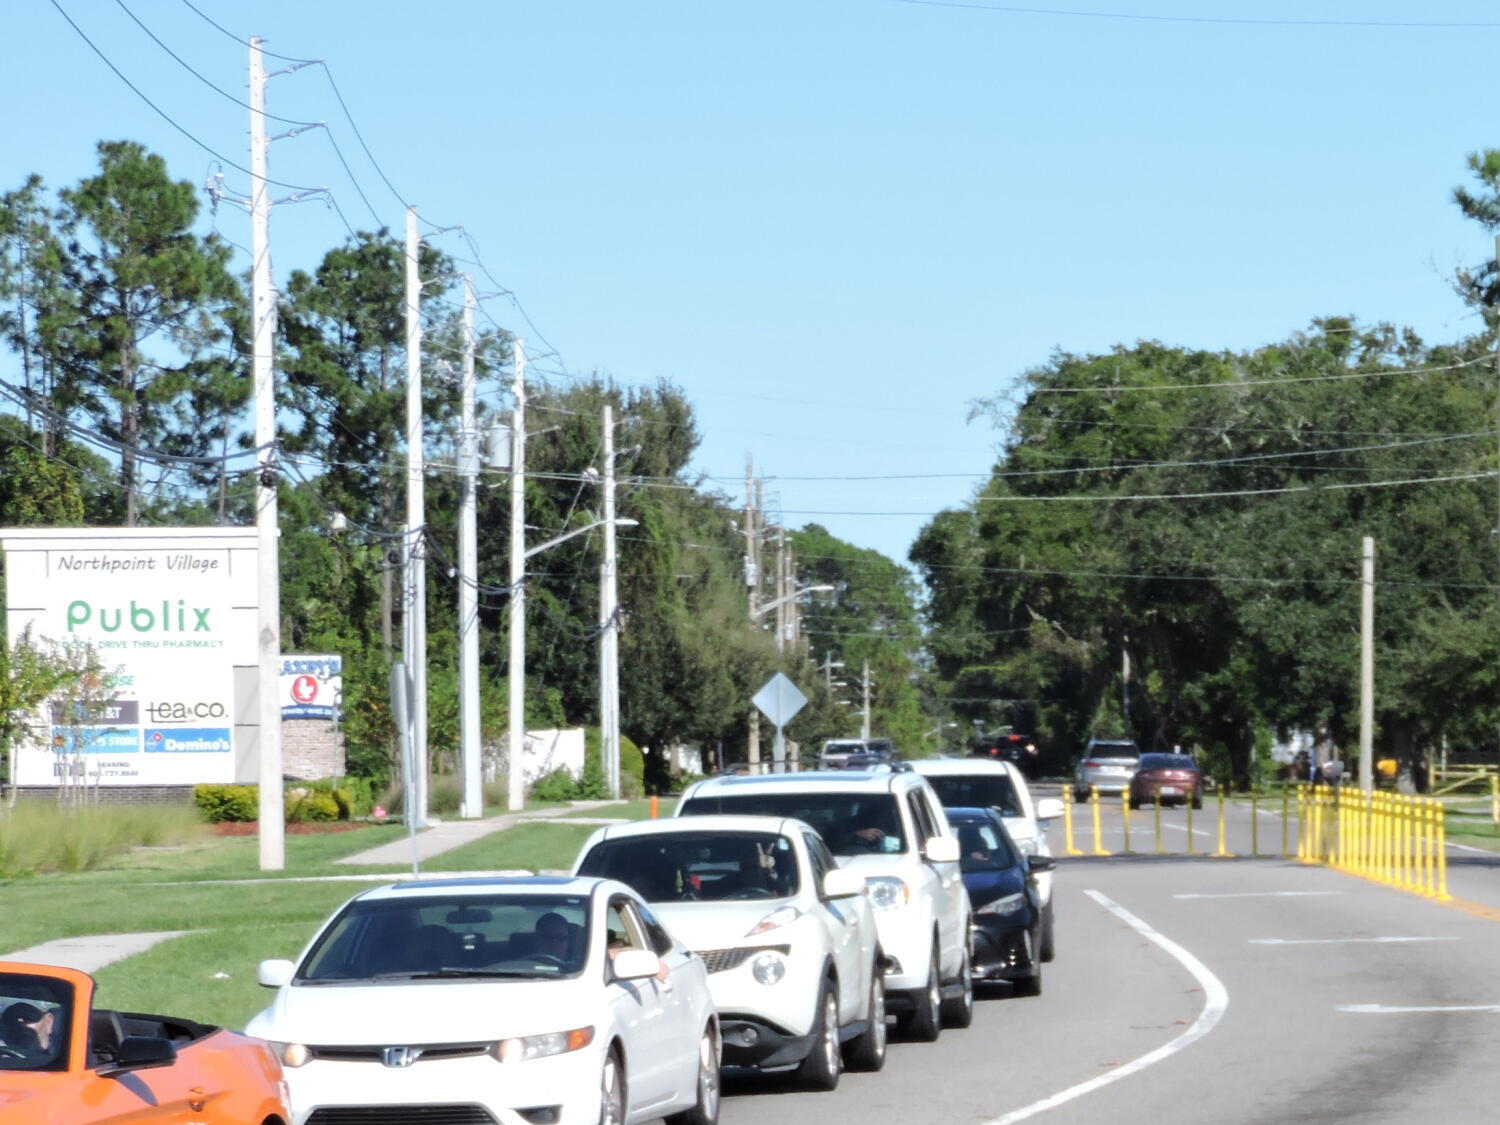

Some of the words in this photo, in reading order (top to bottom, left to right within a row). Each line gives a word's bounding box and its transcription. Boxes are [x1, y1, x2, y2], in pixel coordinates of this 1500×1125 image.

[58, 554, 156, 574] Northpoint
[166, 554, 219, 573] Village
[66, 599, 211, 633] Publix
[98, 640, 128, 649] DRIVE
[132, 640, 159, 648] THRU
[162, 639, 224, 648] PHARMACY
[283, 658, 340, 674] AXBY'S
[165, 737, 230, 751] Domino's
